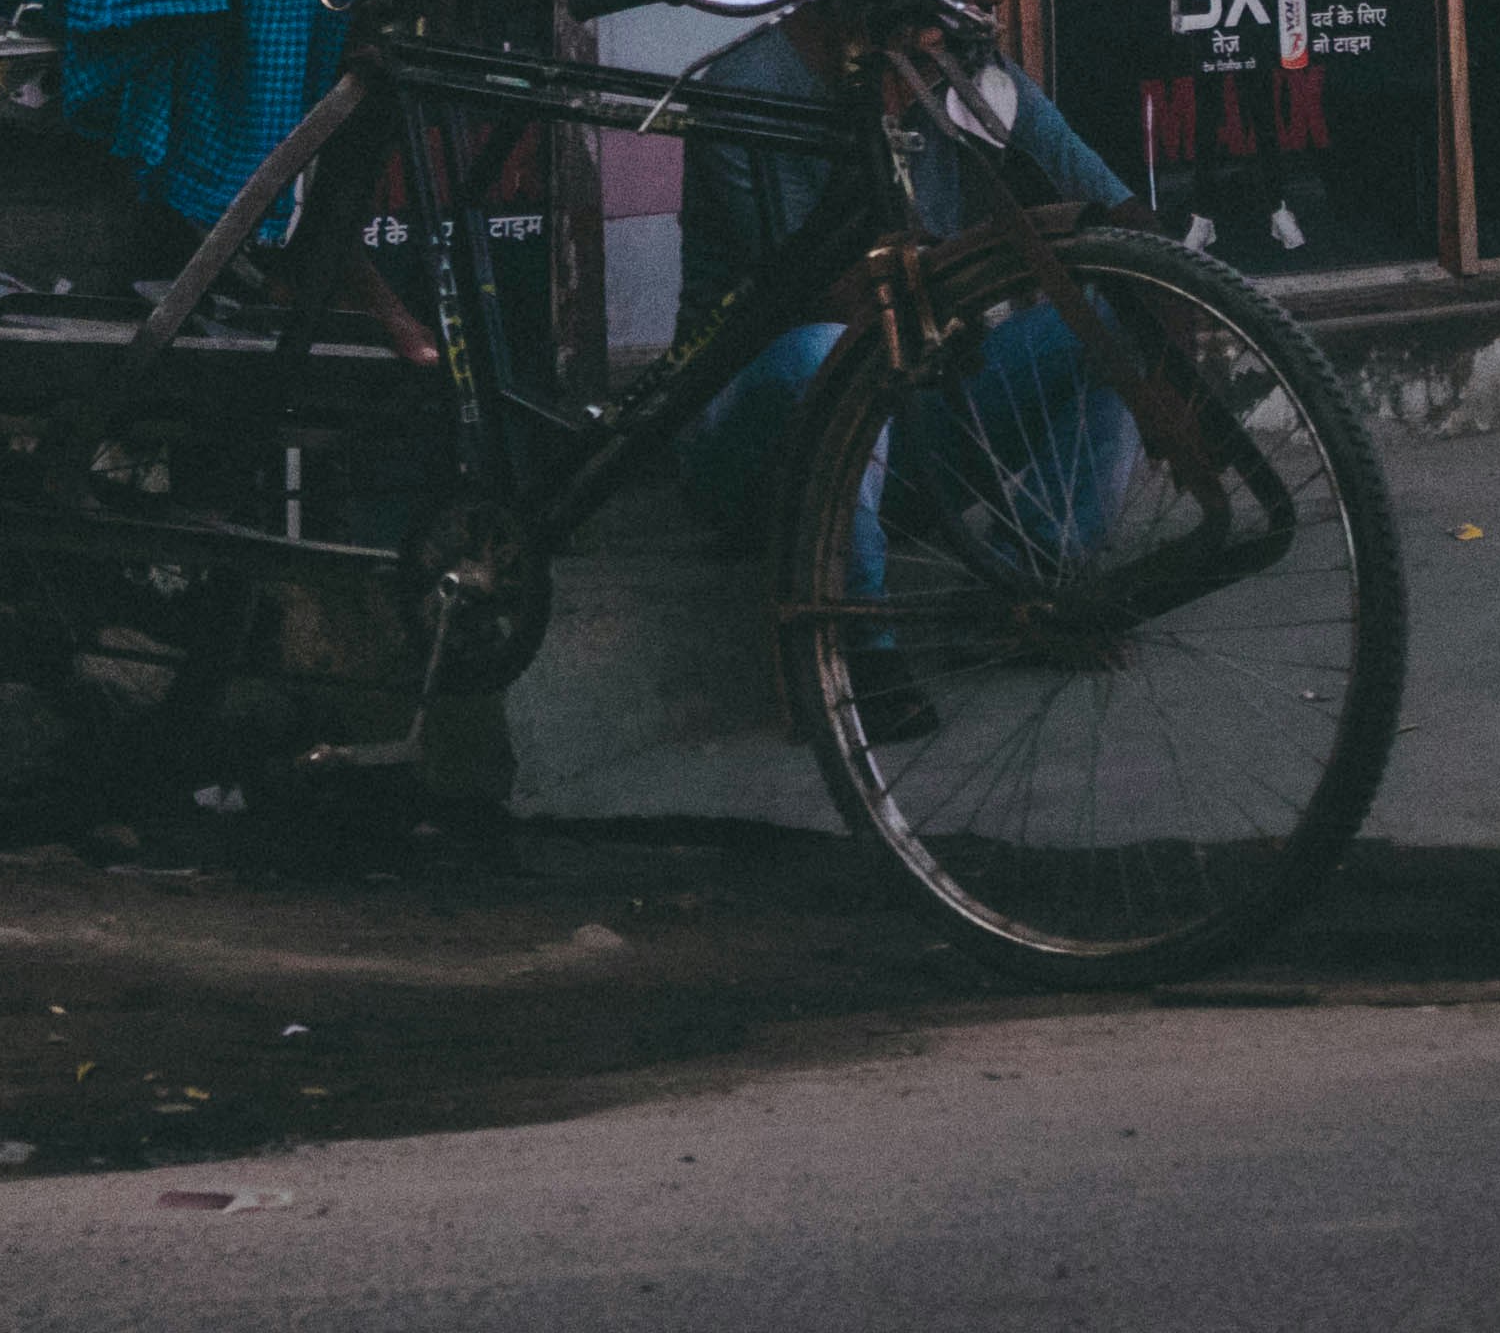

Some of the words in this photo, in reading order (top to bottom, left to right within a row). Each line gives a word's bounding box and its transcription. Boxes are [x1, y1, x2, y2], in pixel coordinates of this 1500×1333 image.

[1310, 4, 1335, 27] दर्द
[1336, 4, 1354, 26] के
[1356, 2, 1388, 28] लिए
[1332, 34, 1373, 56] टाइम
[488, 214, 543, 242] टाइम
